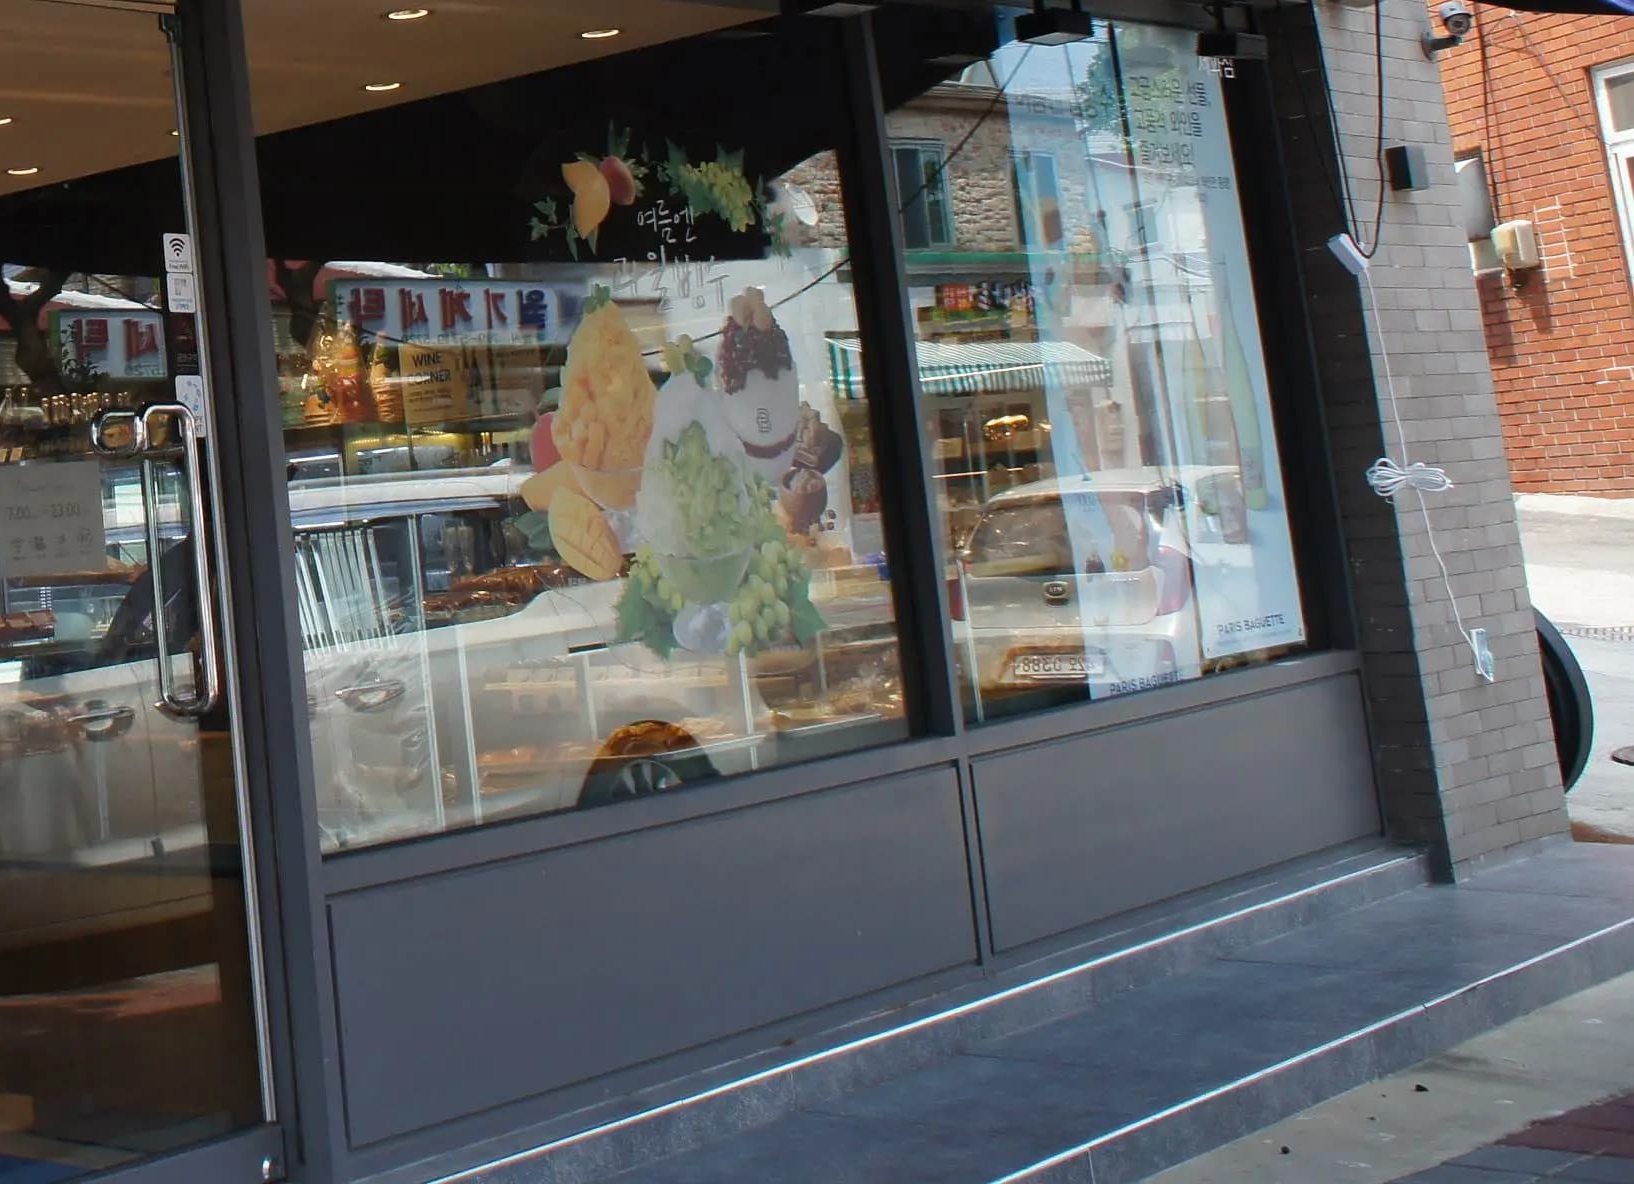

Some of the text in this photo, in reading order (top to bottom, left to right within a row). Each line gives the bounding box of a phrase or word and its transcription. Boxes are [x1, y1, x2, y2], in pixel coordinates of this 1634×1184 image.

[637, 200, 697, 243] 여름엔
[412, 351, 443, 367] WINE
[1218, 614, 1286, 634] PARIS BAGUETTE
[1110, 680, 1137, 695] PARIS
